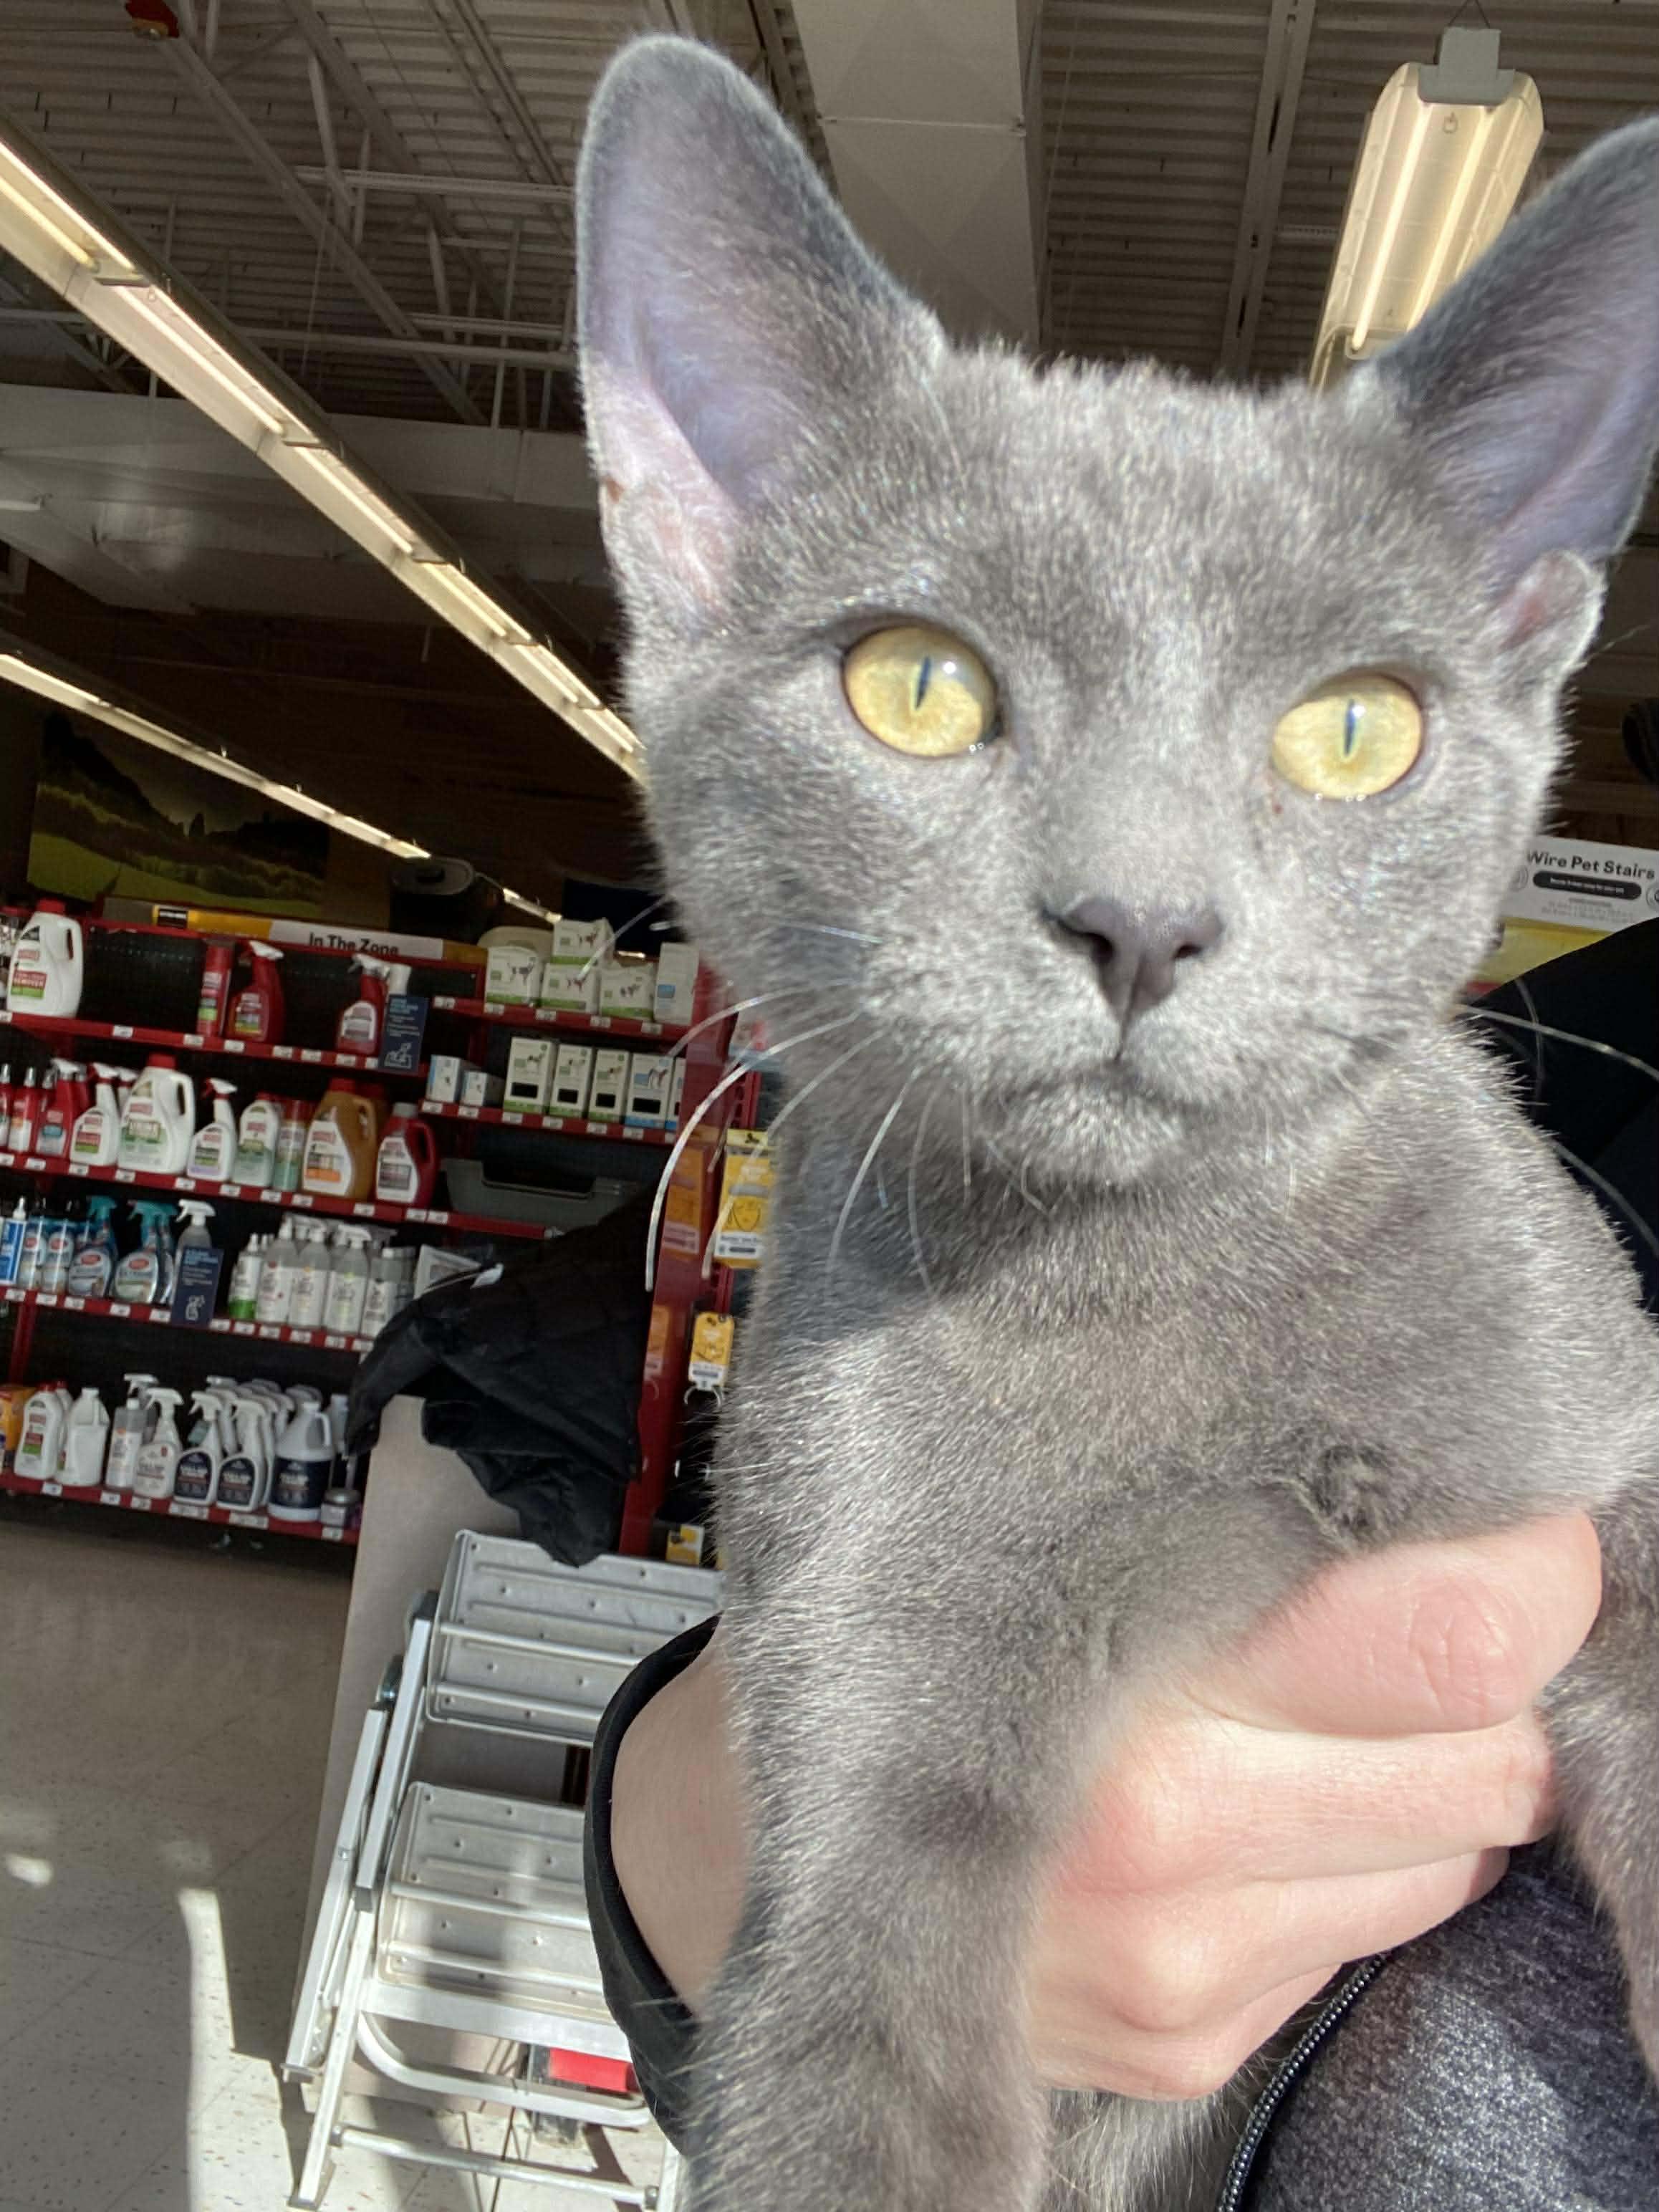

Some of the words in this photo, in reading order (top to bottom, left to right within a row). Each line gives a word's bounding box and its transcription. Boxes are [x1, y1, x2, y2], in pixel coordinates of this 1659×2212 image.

[1527, 851, 1567, 867] Wire
[1571, 855, 1600, 872] Pet
[1603, 860, 1655, 880] Stairs
[309, 933, 324, 946] In
[327, 935, 356, 952] The
[359, 938, 399, 956] Zone
